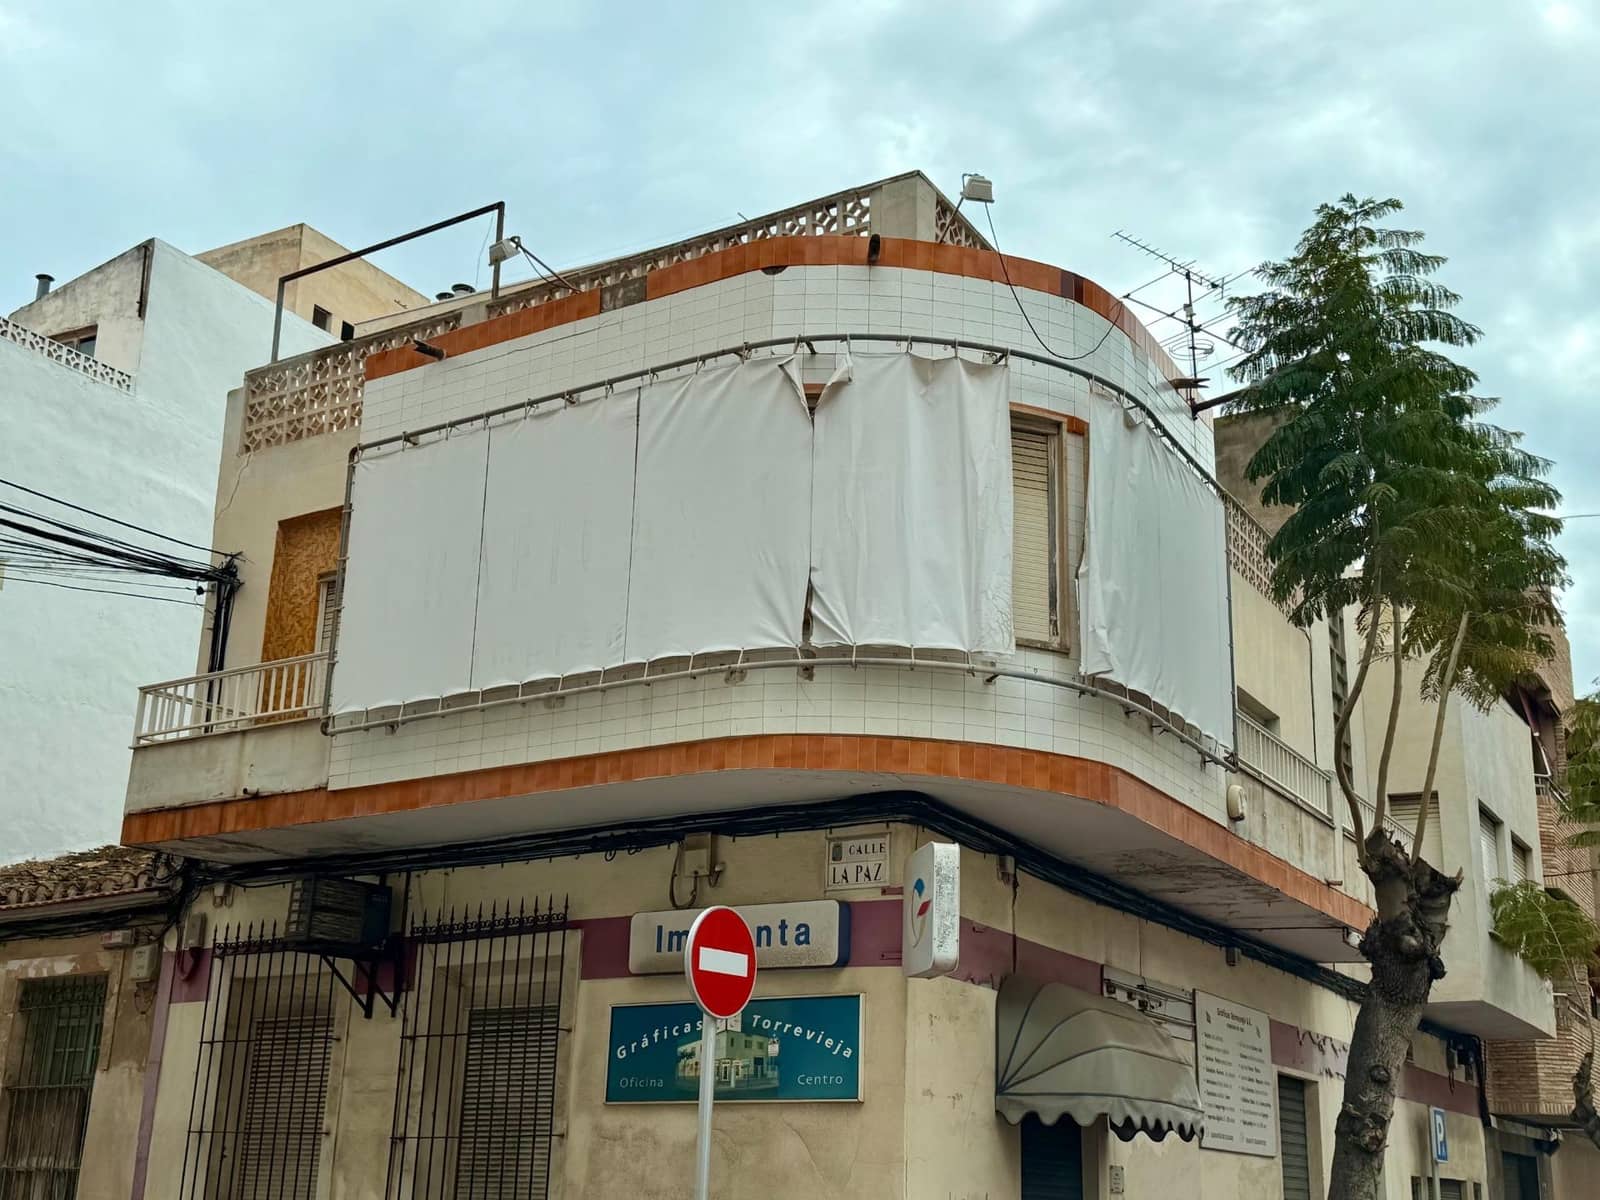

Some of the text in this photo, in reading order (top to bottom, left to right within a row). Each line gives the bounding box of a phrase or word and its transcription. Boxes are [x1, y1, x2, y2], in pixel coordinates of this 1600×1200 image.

[849, 842, 887, 855] CALLE
[832, 863, 882, 884] LA PAZ
[656, 919, 811, 953] Imnta
[616, 1014, 853, 1059] Gráficas Torrevieja
[619, 1074, 843, 1088] Oficina Centro
[1435, 1114, 1444, 1155] P
